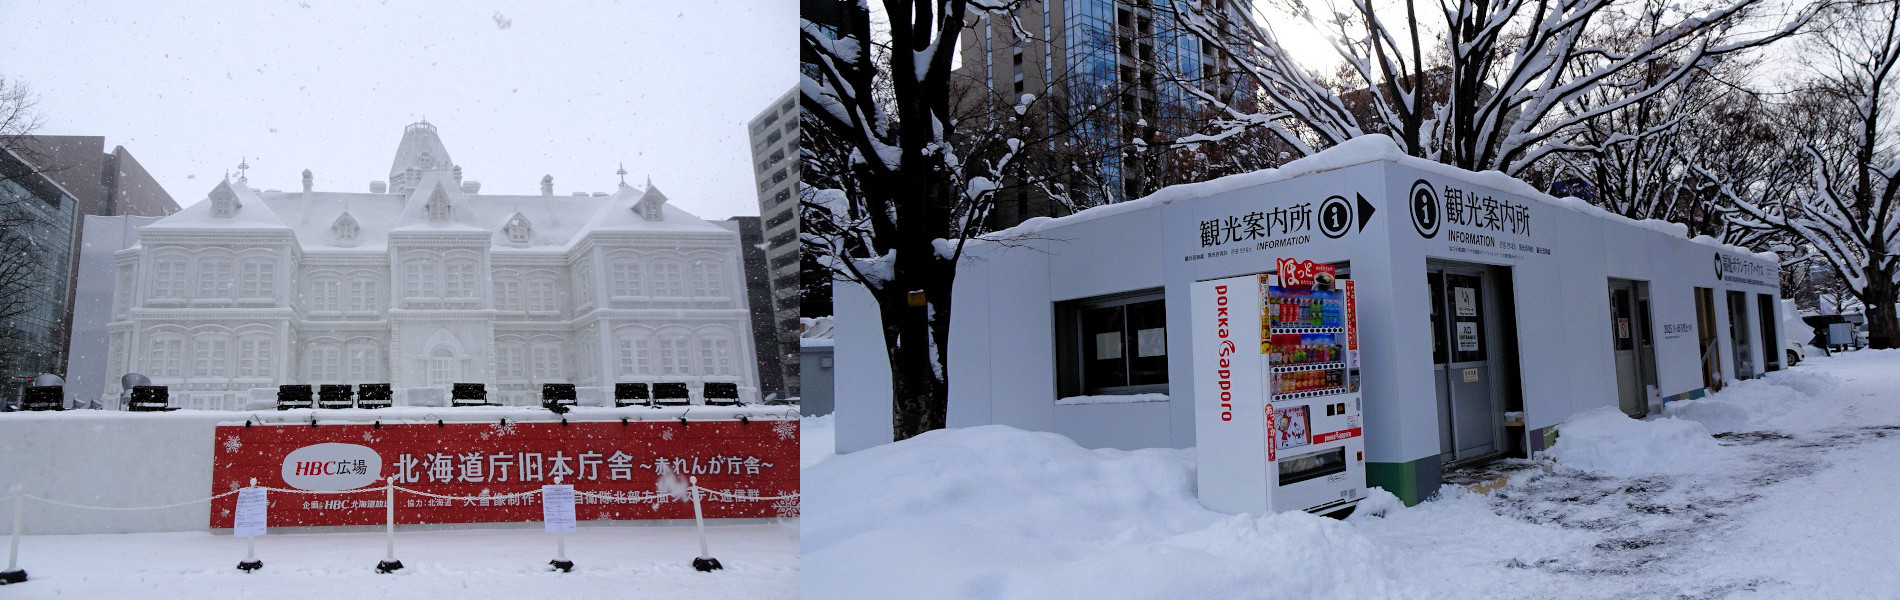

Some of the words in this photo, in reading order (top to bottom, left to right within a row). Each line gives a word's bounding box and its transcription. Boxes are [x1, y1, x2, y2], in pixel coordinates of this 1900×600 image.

[1444, 185, 1530, 237] 観光案内所
[1199, 202, 1313, 248] 観光案内所
[1256, 235, 1311, 251] INFORMATION
[1448, 230, 1495, 247] INFORMATION
[295, 459, 367, 476] HBC広場
[393, 450, 633, 483] 北海道庁旧本庁舎
